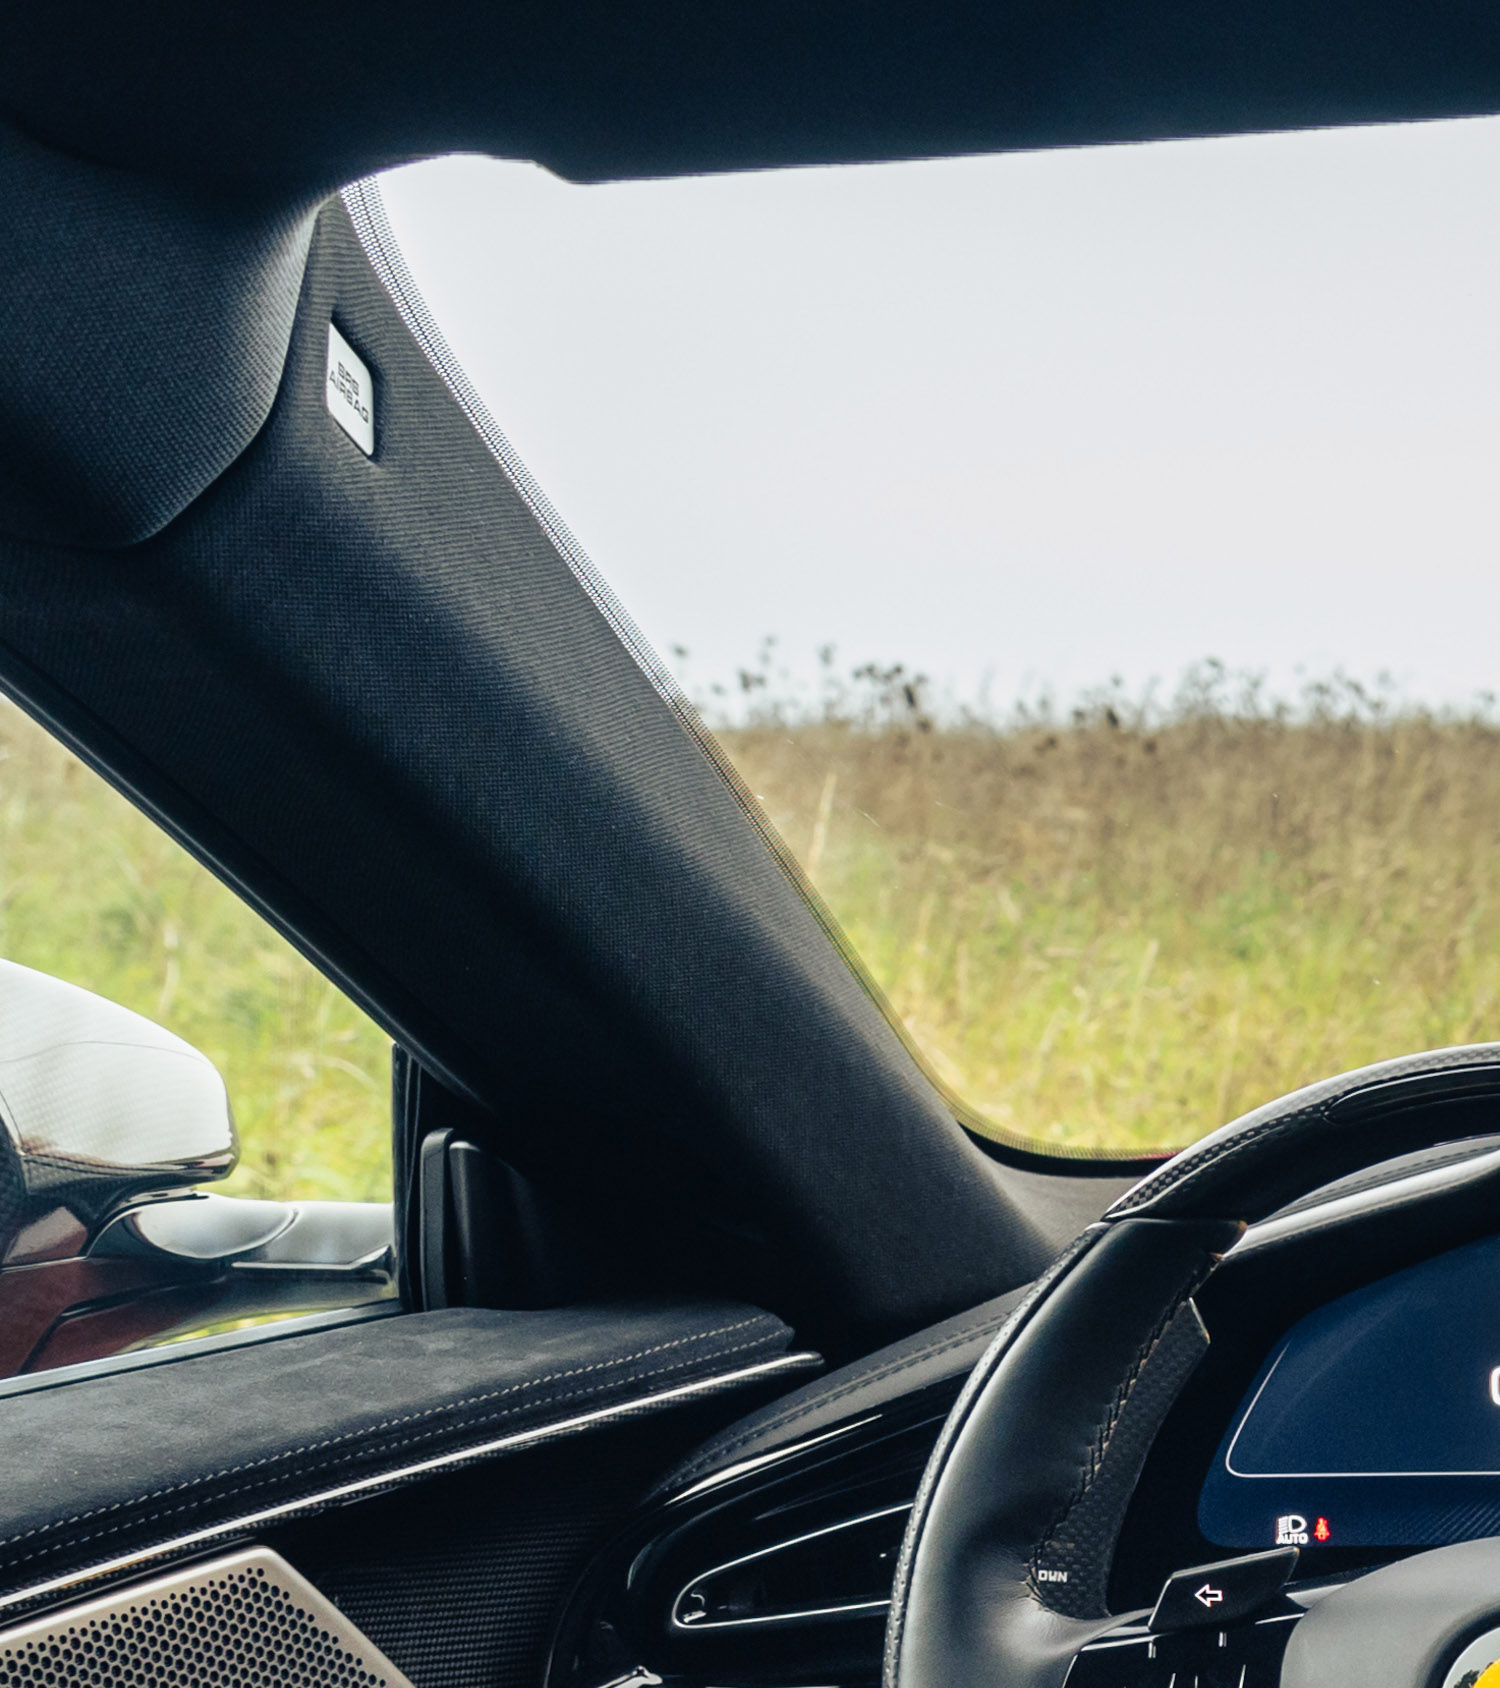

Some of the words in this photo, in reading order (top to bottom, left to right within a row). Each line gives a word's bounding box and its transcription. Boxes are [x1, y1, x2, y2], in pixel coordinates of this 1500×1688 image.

[329, 370, 369, 424] AIRBAG
[1275, 1532, 1308, 1545] AUTO
[1039, 1569, 1068, 1583] OWN
